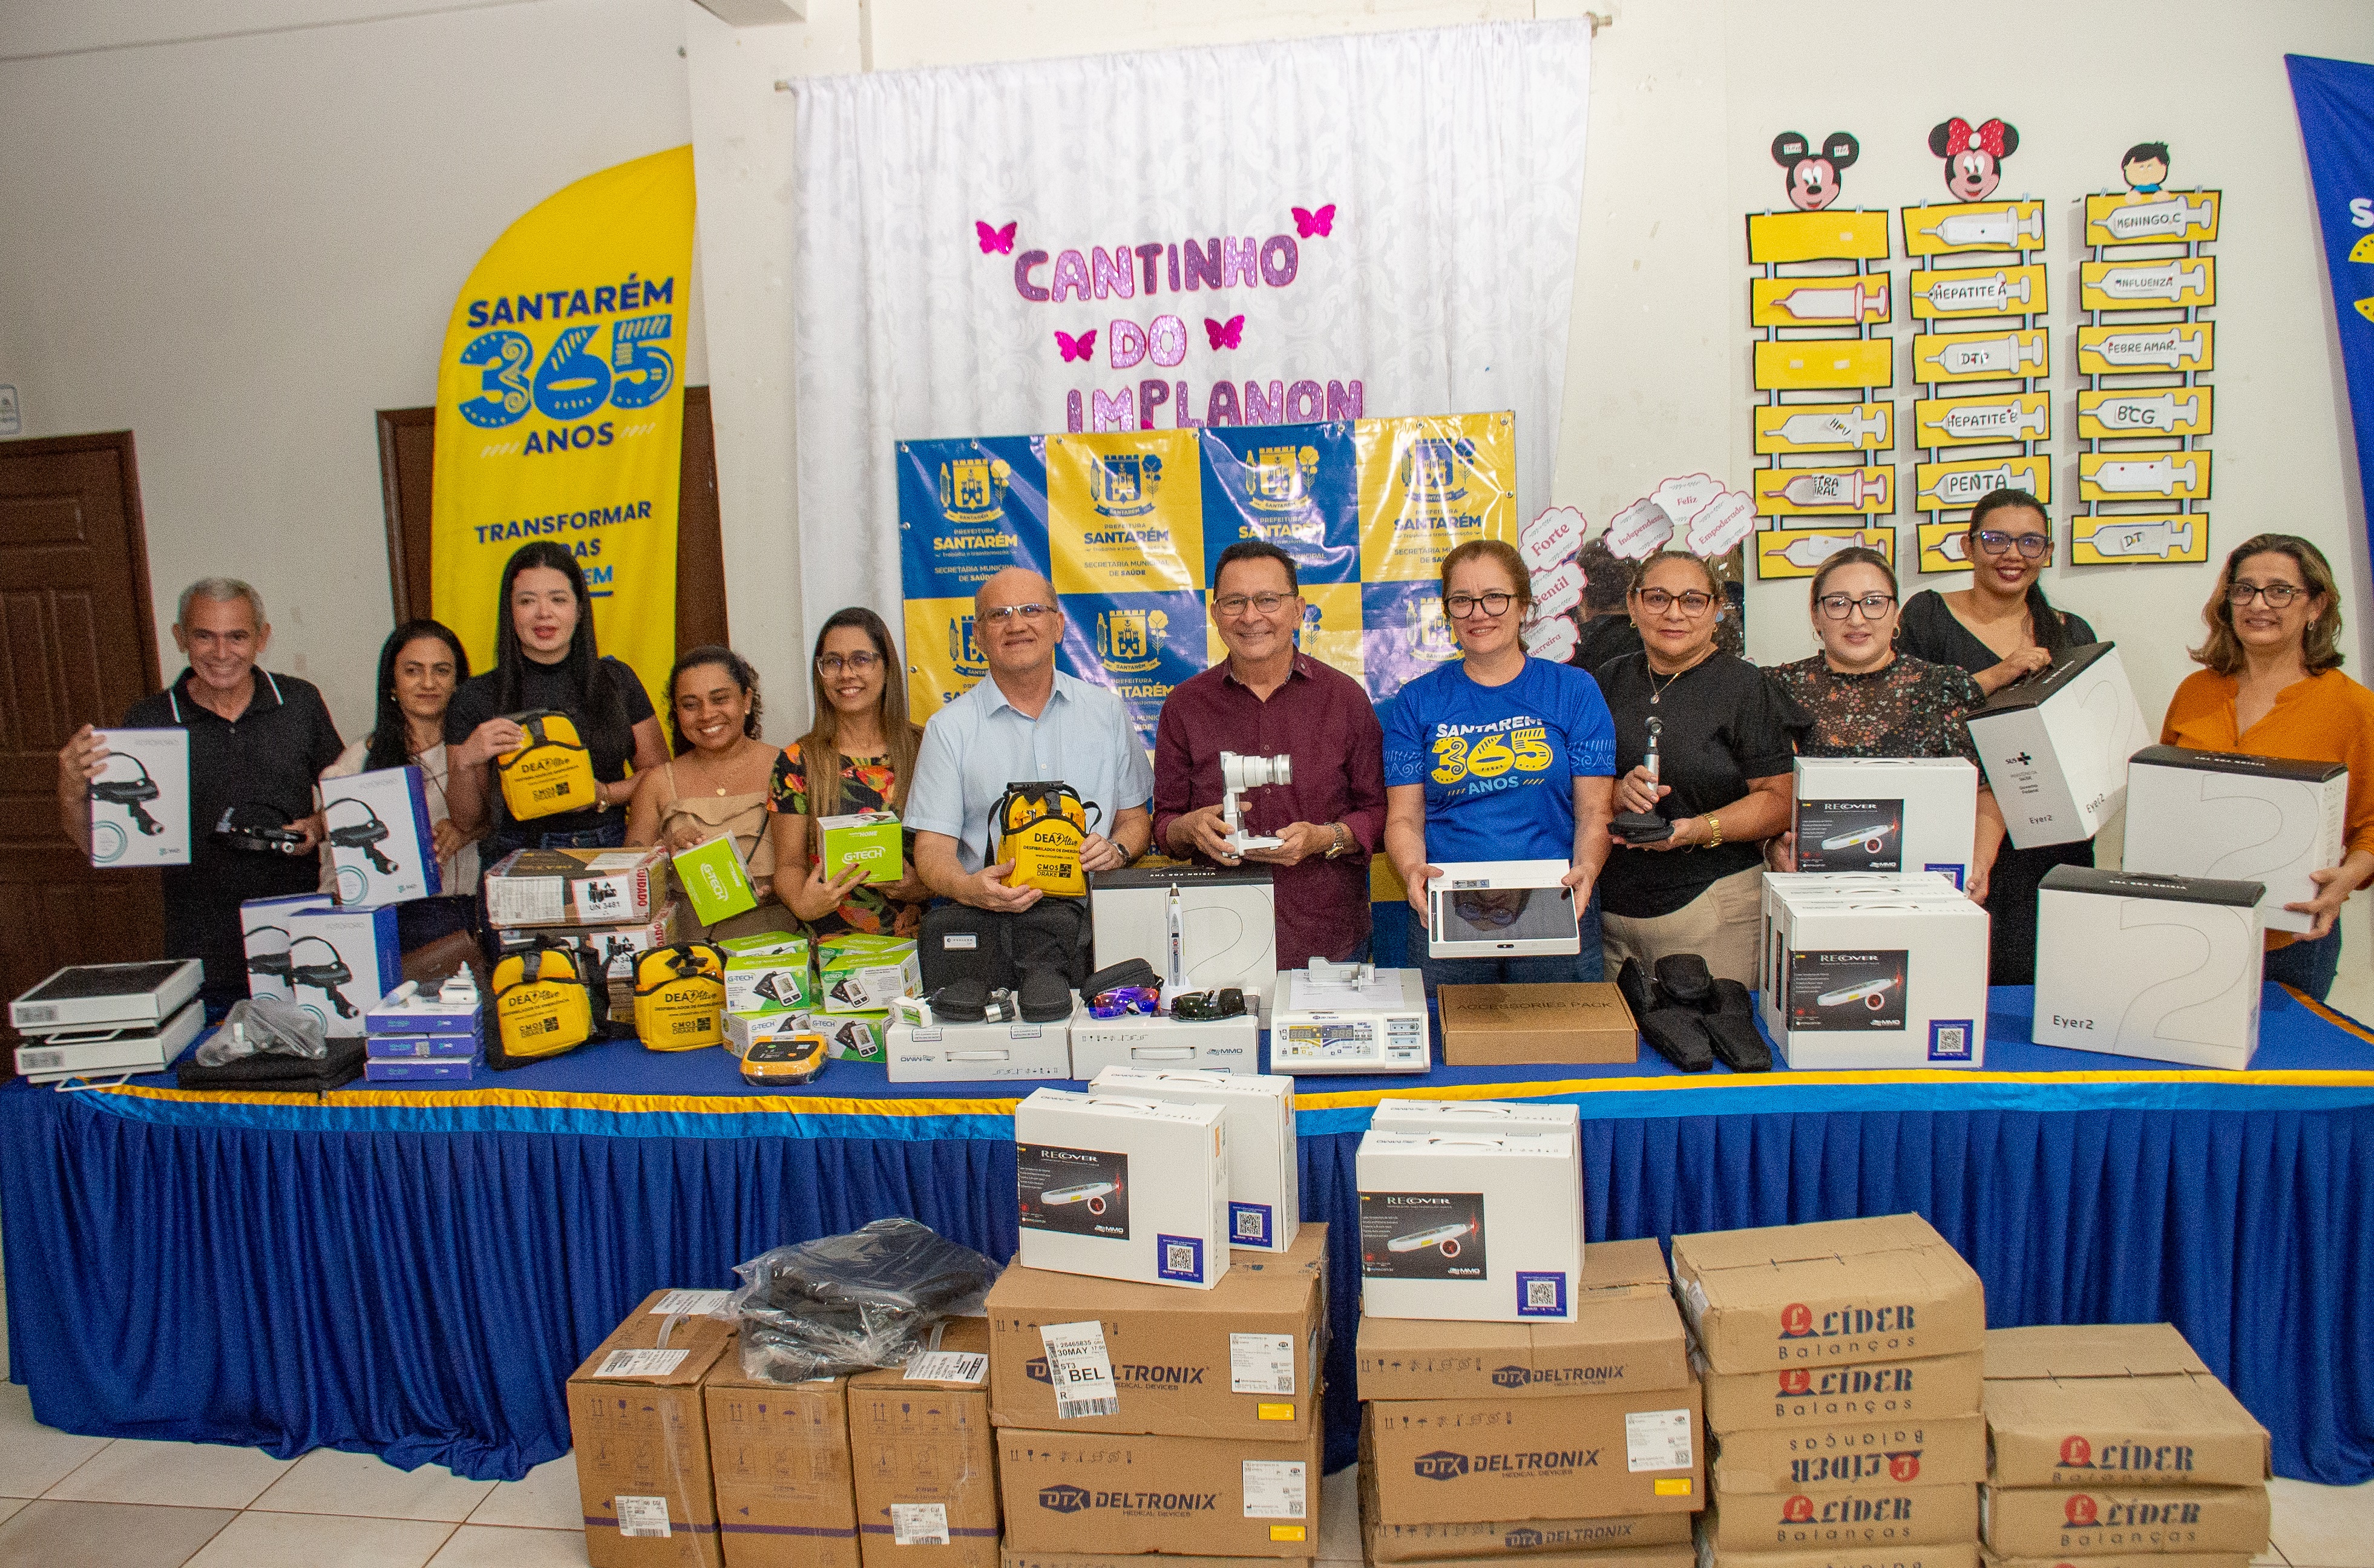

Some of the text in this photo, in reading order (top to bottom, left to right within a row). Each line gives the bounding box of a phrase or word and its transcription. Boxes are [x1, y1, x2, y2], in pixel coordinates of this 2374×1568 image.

[1015, 235, 1297, 302] CANTINHO
[1934, 282, 2007, 301] HEPATITE A
[2117, 277, 2172, 287] INFLUENZA
[467, 273, 674, 329] SANTARÉM
[1110, 315, 1187, 368] DO
[2108, 343, 2142, 354] FEBRE
[458, 314, 674, 429] 365
[1067, 379, 1363, 433] IMPLANON
[2118, 406, 2155, 424] BCG
[1946, 415, 2006, 428] HEPATITE
[523, 422, 614, 456] ANOS
[1812, 475, 1839, 487] ETRA
[1950, 474, 2008, 491] PENTA
[1676, 496, 1698, 507] Feliz
[474, 500, 651, 543] TRANSFORMAR
[1394, 513, 1481, 530] SANTARÉM
[1618, 513, 1665, 546] Independente
[1698, 504, 1745, 545] Empoderada
[934, 532, 1018, 550] SANTARÉM
[1084, 527, 1169, 544] SANTARÉM
[1531, 522, 1570, 557] Forte
[1431, 727, 1553, 784] 365
[1469, 776, 1520, 795] ANOS
[2087, 793, 2105, 813] Eyer2
[2029, 815, 2053, 824] Eyer2
[1034, 833, 1055, 843] DEA
[509, 994, 531, 1007] DEA
[665, 992, 689, 1003] DEA
[2053, 1014, 2094, 1030] Eyer2
[1041, 1150, 1098, 1162] RECOVER
[1387, 1196, 1451, 1205] RECOVER
[1820, 1304, 1916, 1337] LÍDER
[1057, 1347, 1087, 1356] 30MAY
[1779, 1336, 1915, 1360] Balanças
[1069, 1367, 1105, 1382] BEL
[1112, 1363, 1205, 1385] LTRONIX
[1534, 1365, 1625, 1382] DELTRONIX
[1818, 1366, 1914, 1396] LÍDER
[1146, 1383, 1178, 1391] DEVICES
[1776, 1399, 1912, 1417] Balanças
[1789, 1429, 1924, 1451] Balanças
[1474, 1449, 1600, 1473] DELTRONIX
[2100, 1440, 2194, 1472] LÍDER
[1790, 1452, 1882, 1484] LÍDER
[1095, 1491, 1216, 1511] DELTRONIX
[1819, 1495, 1912, 1523] LÍDER
[2107, 1499, 2202, 1527] LÍDER
[1546, 1524, 1633, 1544] DELTRONIX
[1777, 1524, 1910, 1543] Balanças
[2061, 1531, 2196, 1547] Balanças
